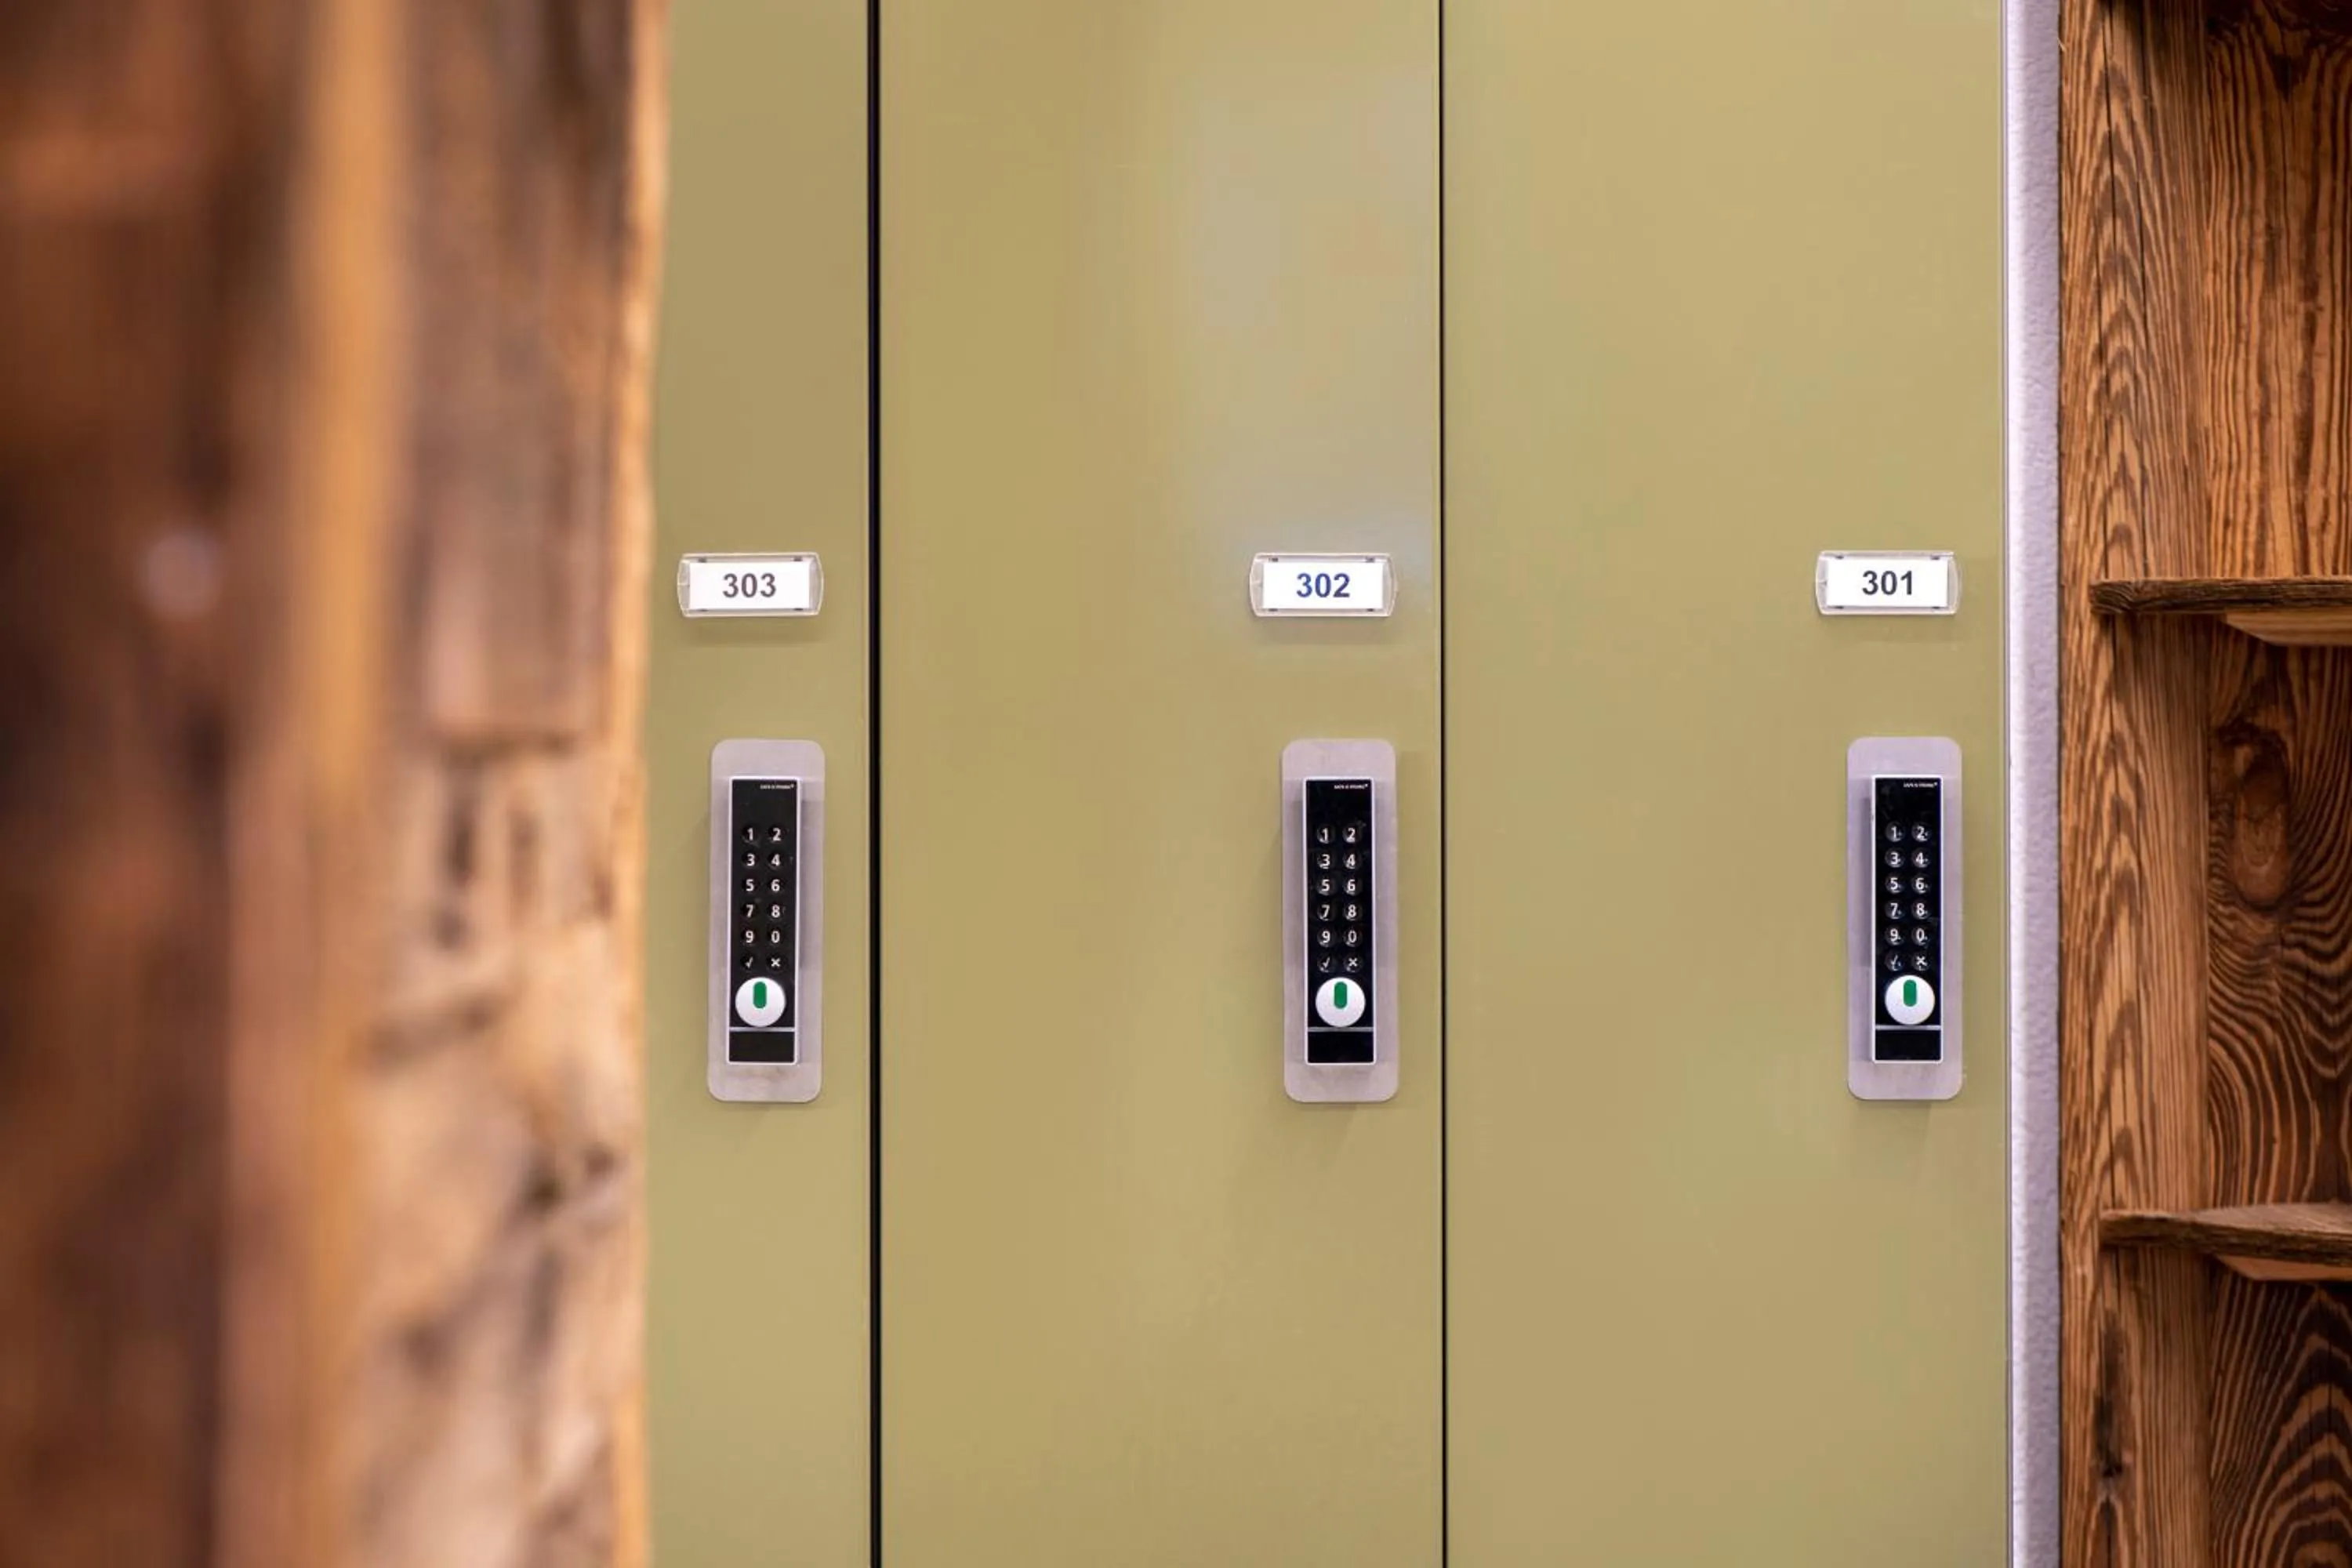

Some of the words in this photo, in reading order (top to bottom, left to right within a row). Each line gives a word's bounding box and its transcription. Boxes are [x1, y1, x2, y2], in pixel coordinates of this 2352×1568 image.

[722, 573, 777, 598] 303
[1296, 572, 1351, 598] 302
[1862, 570, 1913, 595] 301
[747, 827, 753, 841] 1
[772, 827, 781, 841] 2
[1322, 828, 1328, 841] 1
[1347, 827, 1356, 842] 2
[1891, 826, 1897, 840] 1
[1916, 826, 1925, 840] 2
[746, 853, 755, 866] 3
[771, 853, 781, 866] 4
[1321, 854, 1330, 866] 3
[1347, 854, 1356, 866] 4
[1890, 851, 1899, 865] 3
[1915, 852, 1925, 865] 4
[746, 879, 754, 891] 5
[771, 879, 780, 892] 6
[1321, 879, 1330, 891] 5
[1347, 879, 1356, 891] 6
[1890, 877, 1898, 890] 5
[1915, 877, 1925, 890] 6
[746, 904, 753, 918] 7
[771, 905, 781, 918] 8
[1321, 904, 1330, 918] 7
[1348, 904, 1357, 918] 8
[1890, 902, 1898, 916] 7
[1916, 902, 1925, 916] 8
[746, 930, 754, 943] 9
[771, 931, 780, 943] 0
[1322, 931, 1330, 943] 9
[1348, 930, 1357, 943] 0
[1890, 928, 1898, 942] 9
[1915, 928, 1925, 942] 0
